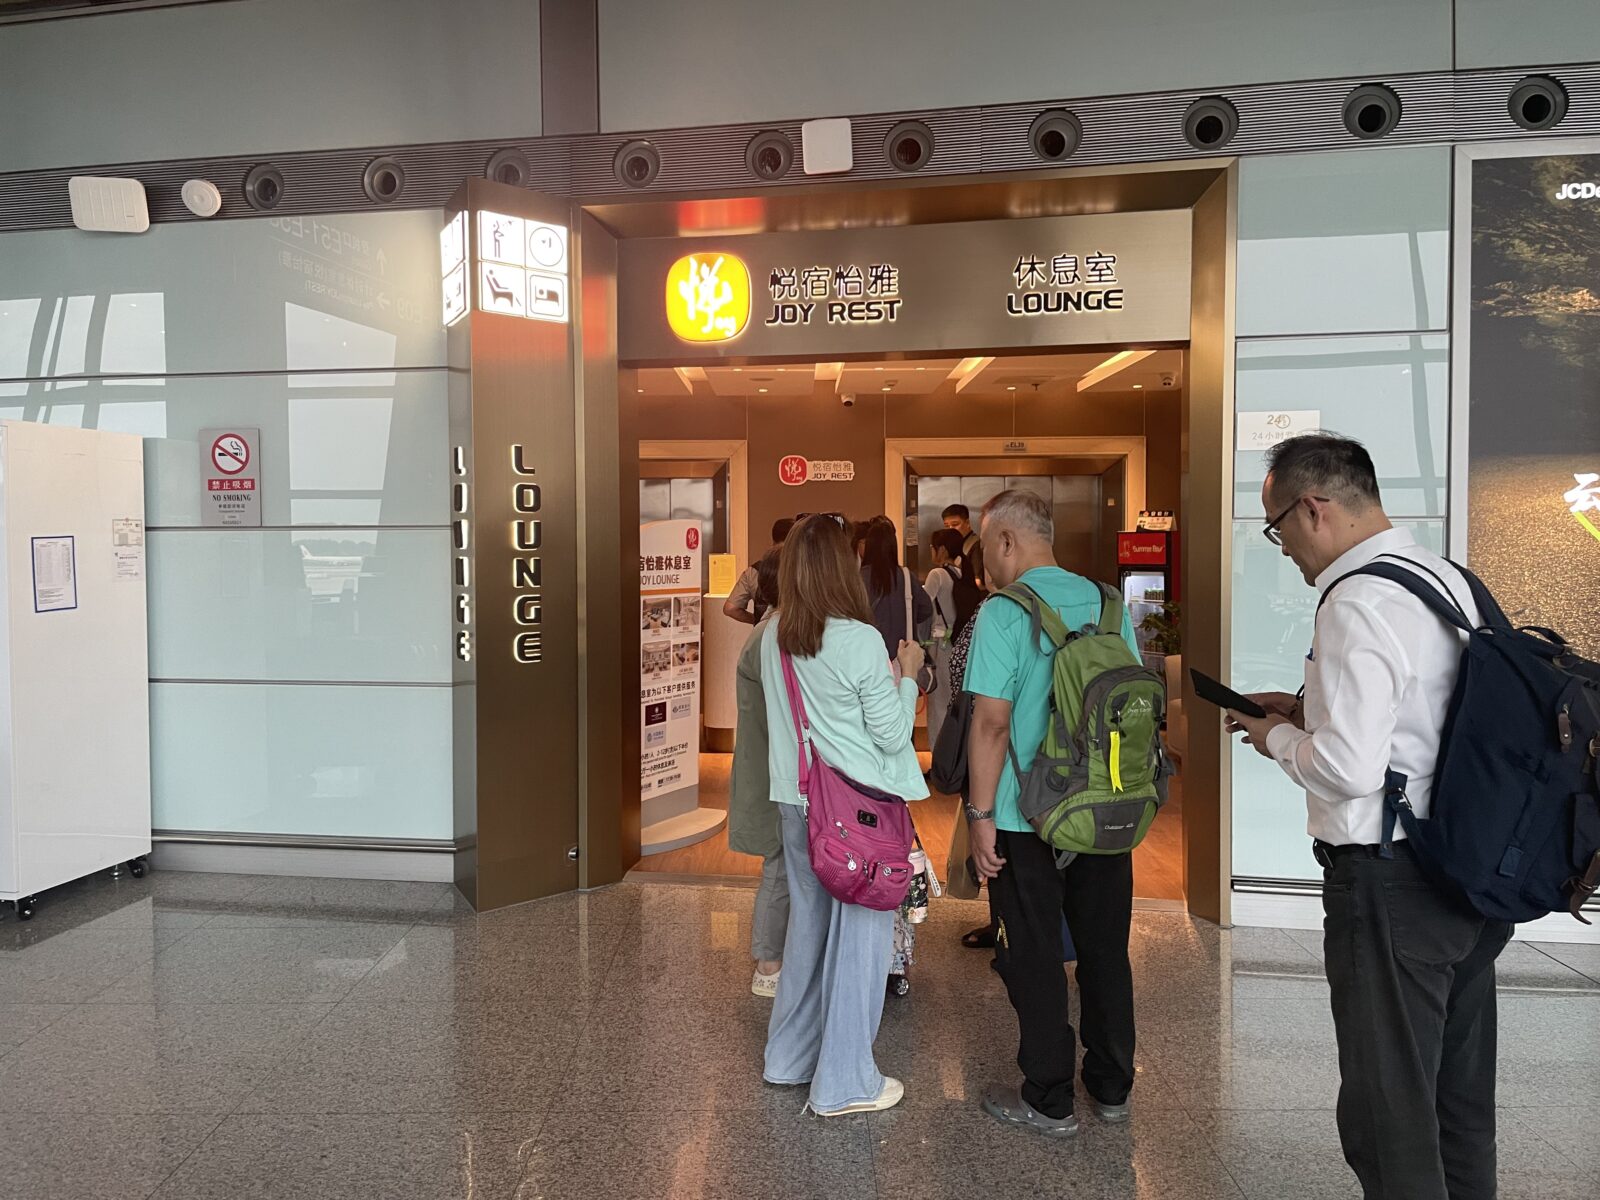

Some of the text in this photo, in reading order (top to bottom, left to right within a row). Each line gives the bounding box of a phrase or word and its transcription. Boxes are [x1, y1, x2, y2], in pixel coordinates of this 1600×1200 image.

[1013, 250, 1119, 288] 休息室
[769, 264, 899, 301] 悦宿怡雅
[1006, 288, 1124, 316] LOUNGE
[765, 299, 903, 327] JOY REST
[812, 472, 854, 480] JOY REST
[813, 462, 852, 472] 悦宿怡雅
[212, 480, 252, 490] 禁止吸烟
[212, 494, 252, 502] NO SMOKING
[510, 444, 543, 664] LOUNGE
[652, 573, 680, 586] LOUNGE
